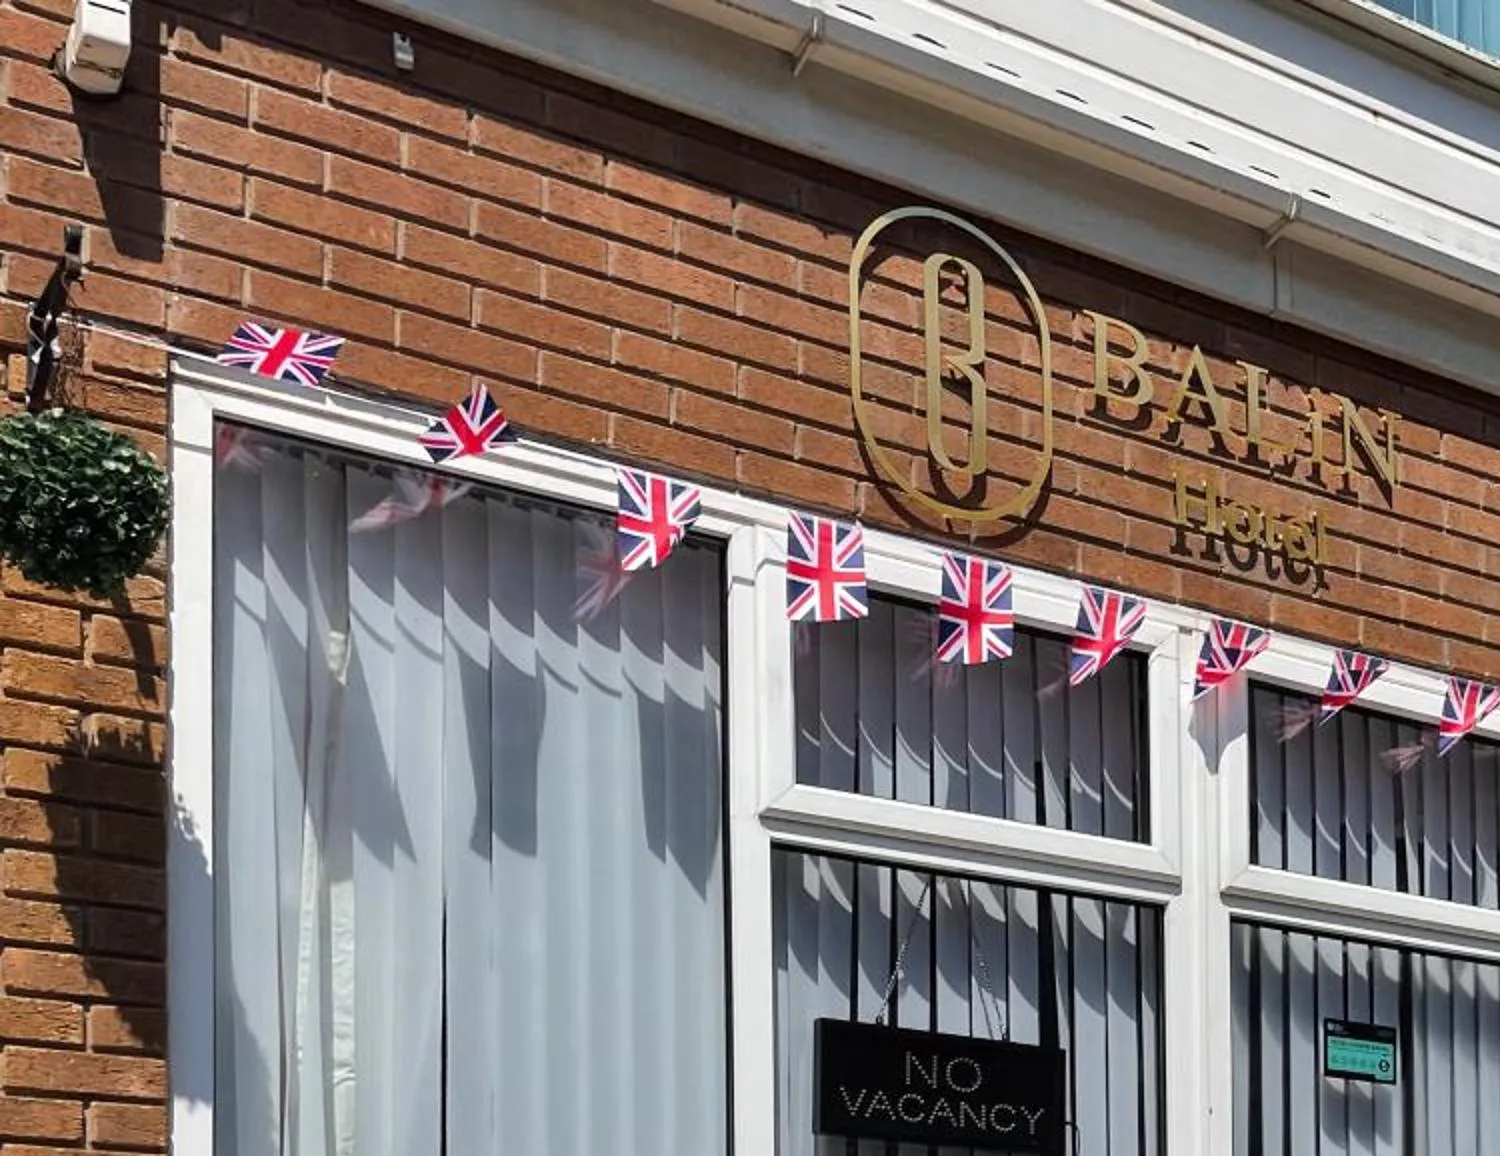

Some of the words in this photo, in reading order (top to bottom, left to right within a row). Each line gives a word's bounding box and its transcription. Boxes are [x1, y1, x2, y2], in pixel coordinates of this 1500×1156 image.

[1081, 309, 1402, 492] BALIN
[1172, 464, 1332, 566] Hotel
[905, 1050, 982, 1093] NO
[839, 1085, 1045, 1134] VACANCY
